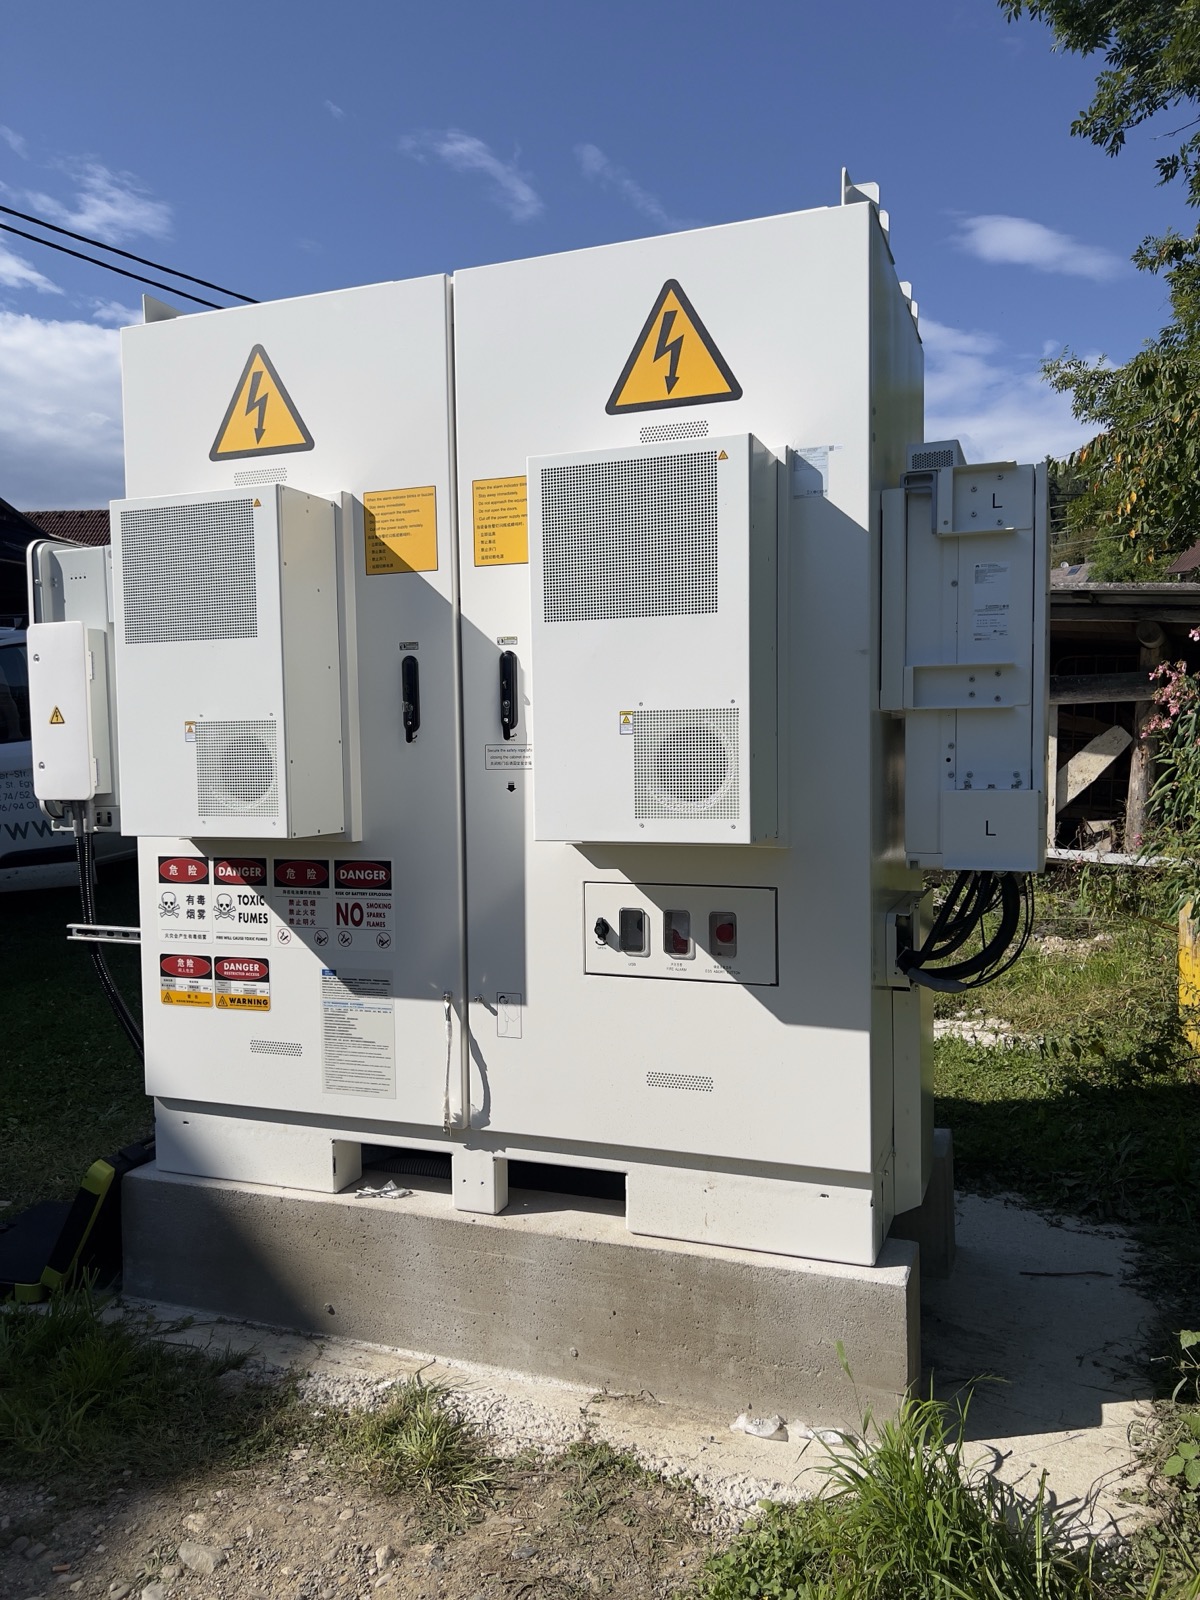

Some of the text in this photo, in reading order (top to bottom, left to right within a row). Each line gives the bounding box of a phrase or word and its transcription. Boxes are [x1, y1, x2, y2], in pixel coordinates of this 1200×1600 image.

[993, 493, 1003, 508] L
[986, 820, 996, 836] L
[169, 865, 198, 876] 危险
[218, 867, 262, 877] DANGER
[340, 870, 386, 880] DANGER
[186, 895, 206, 906] 有毒
[238, 895, 265, 906] TOXIC
[186, 909, 206, 920] 烟雾
[238, 913, 269, 924] FUMES
[336, 902, 364, 927] NO
[177, 958, 194, 968] 危险
[224, 963, 260, 972] DANGER
[229, 997, 268, 1006] WARNING
